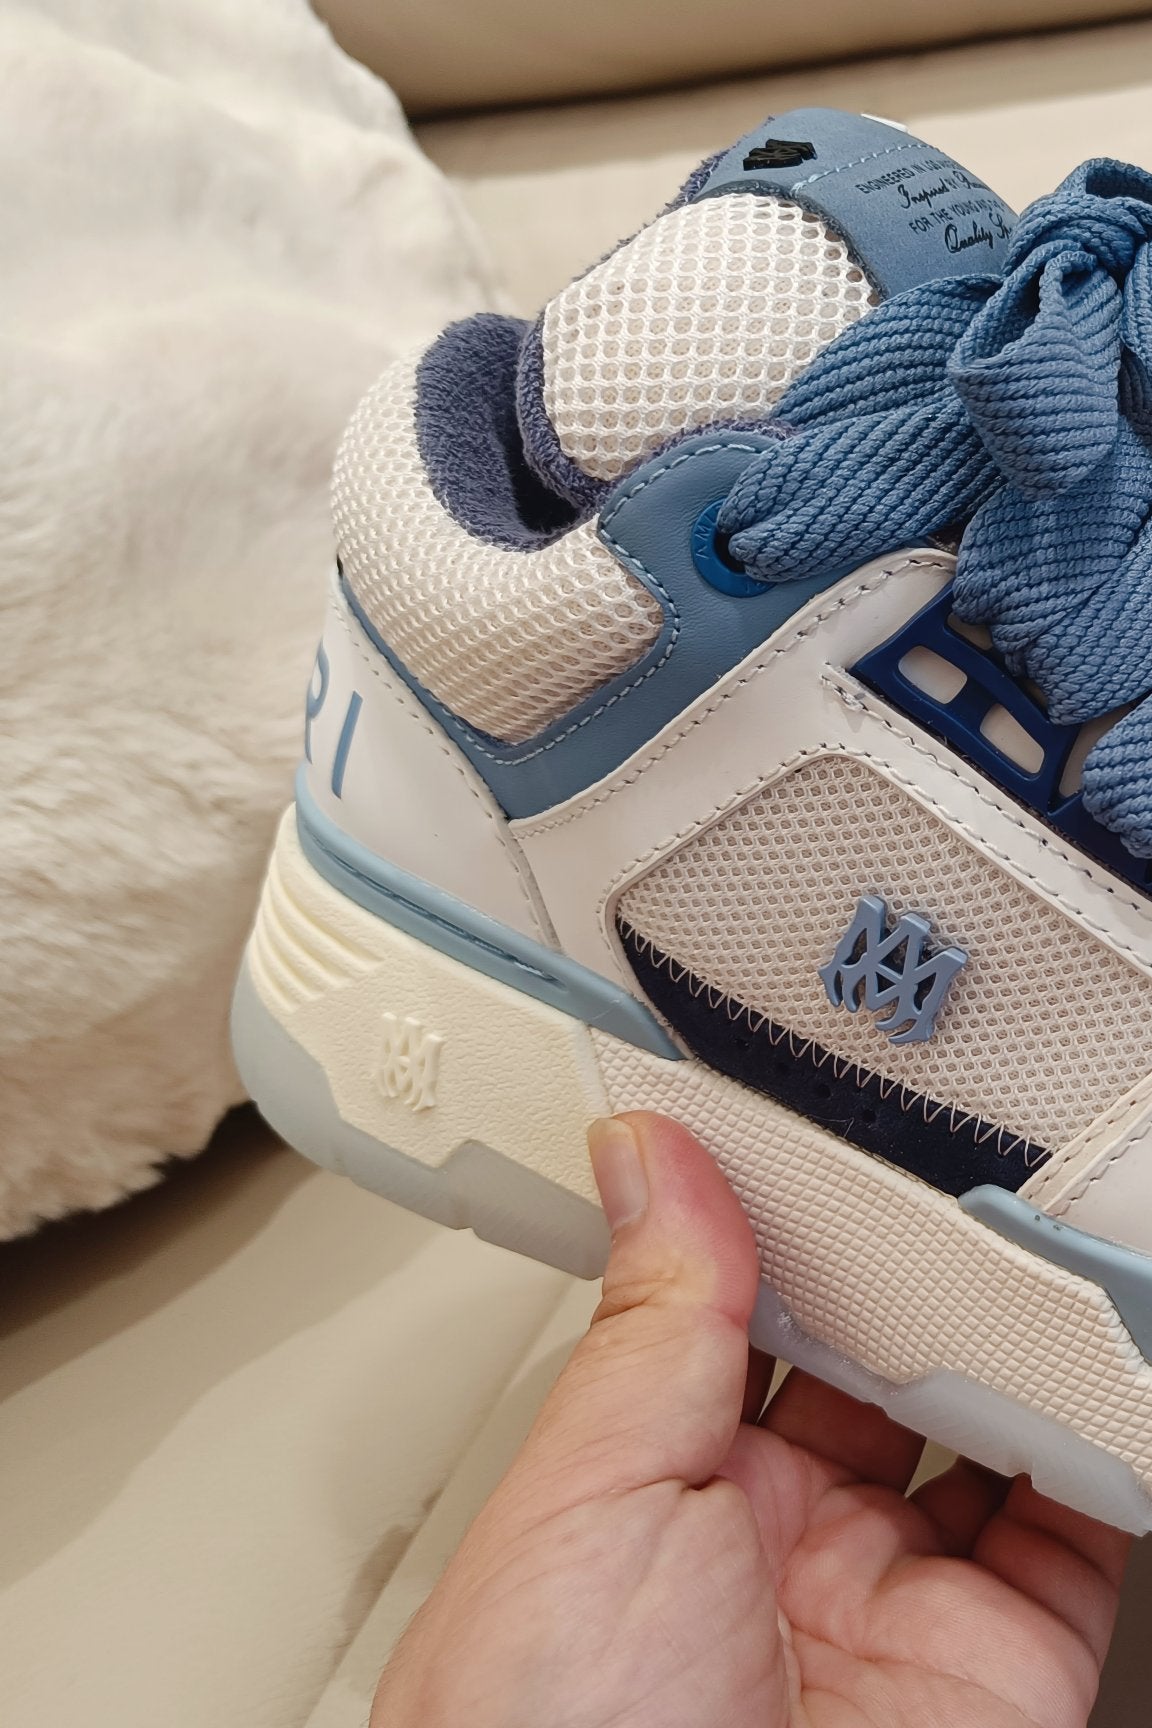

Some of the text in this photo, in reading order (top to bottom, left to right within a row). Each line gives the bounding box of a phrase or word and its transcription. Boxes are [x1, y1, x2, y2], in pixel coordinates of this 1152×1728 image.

[855, 167, 915, 194] ENGINEERED
[898, 178, 950, 208] Inspired
[908, 213, 935, 235] FOR
[931, 208, 955, 226] THE
